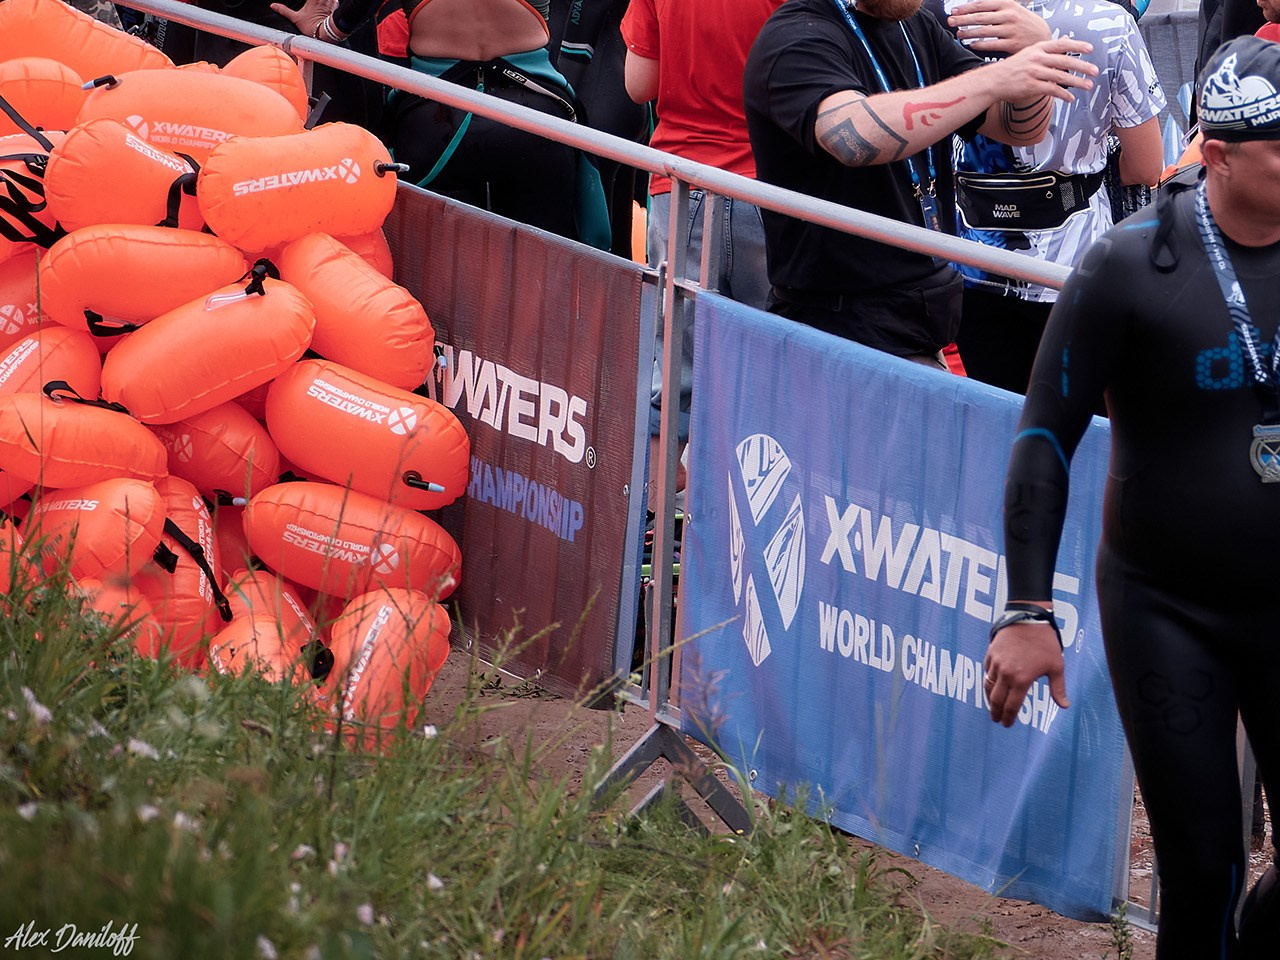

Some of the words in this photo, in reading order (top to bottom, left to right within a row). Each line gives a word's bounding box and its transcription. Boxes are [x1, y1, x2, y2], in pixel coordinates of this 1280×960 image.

[992, 210, 1020, 218] WAVE
[820, 495, 1080, 649] X·WATES
[819, 601, 895, 673] WORLD
[902, 634, 1060, 735] CHAMPISHI
